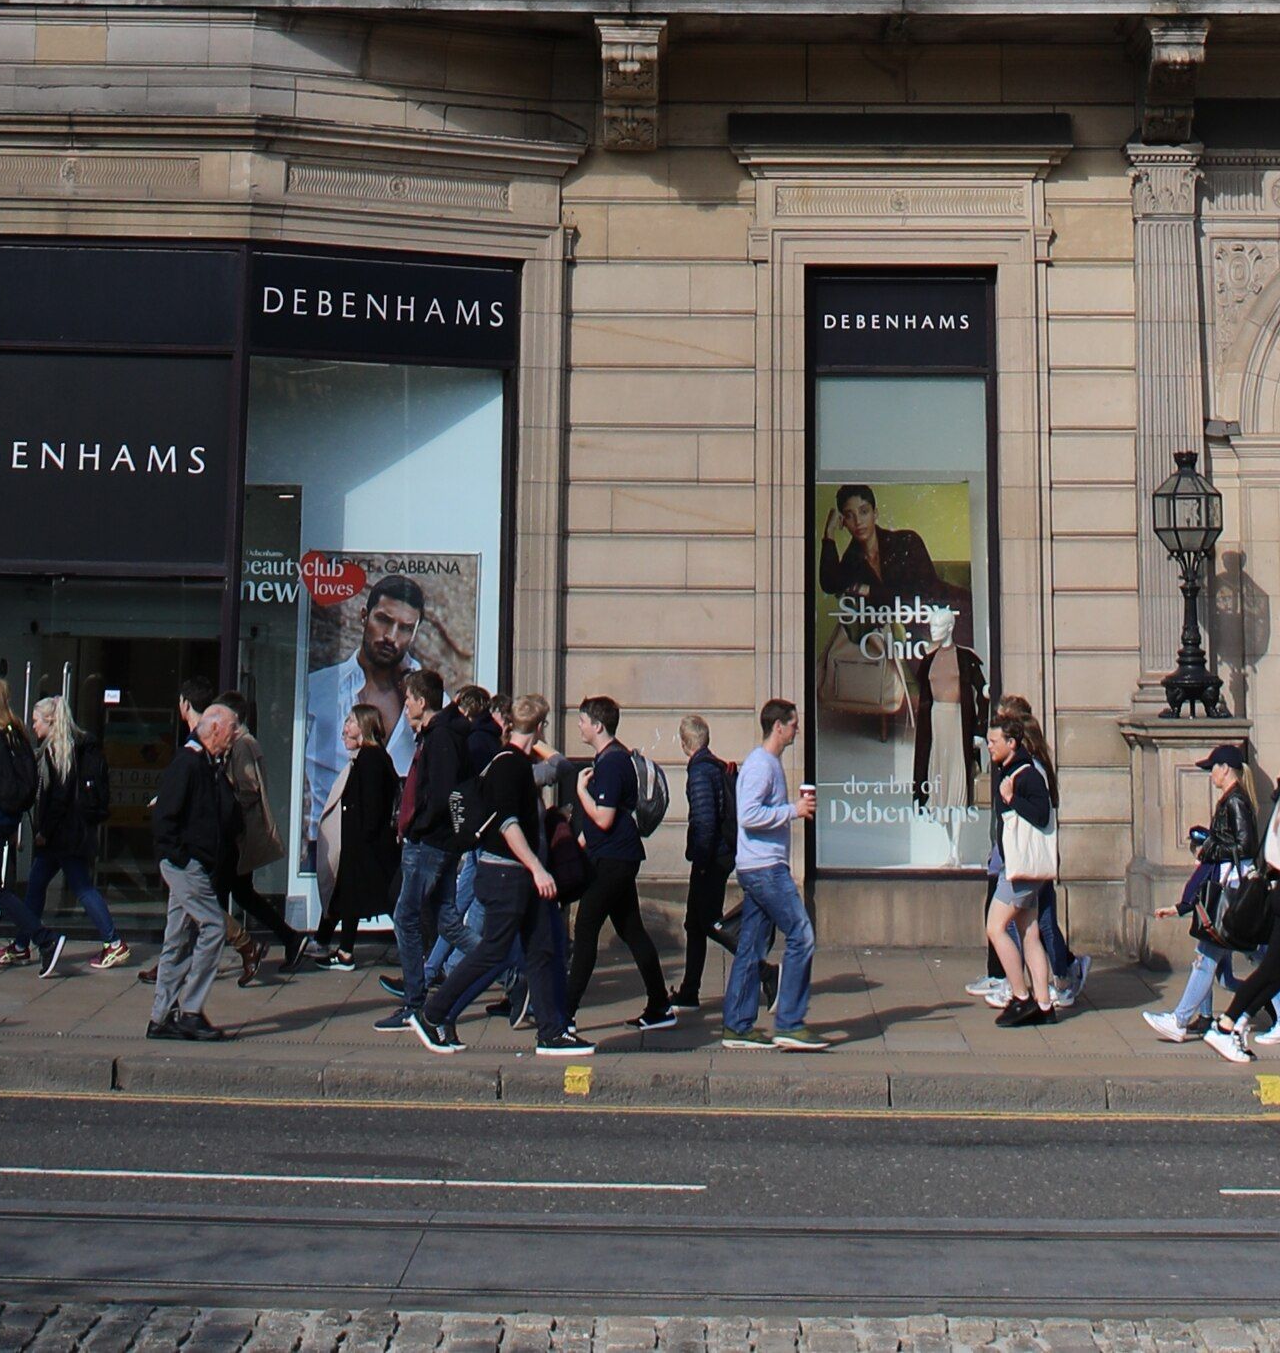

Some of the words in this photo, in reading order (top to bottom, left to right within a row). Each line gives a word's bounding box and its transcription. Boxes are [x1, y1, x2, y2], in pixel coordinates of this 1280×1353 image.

[263, 286, 505, 328] DEBENHAMS
[823, 314, 970, 330] DEBENHAMS
[385, 559, 461, 576] GABBANA
[314, 578, 354, 596] loves
[838, 596, 951, 625] Shabb
[859, 631, 930, 660] Chic
[842, 774, 869, 795] do
[873, 780, 885, 795] a
[889, 774, 916, 795] bit
[920, 774, 942, 794] of
[829, 799, 981, 824] Debenhams
